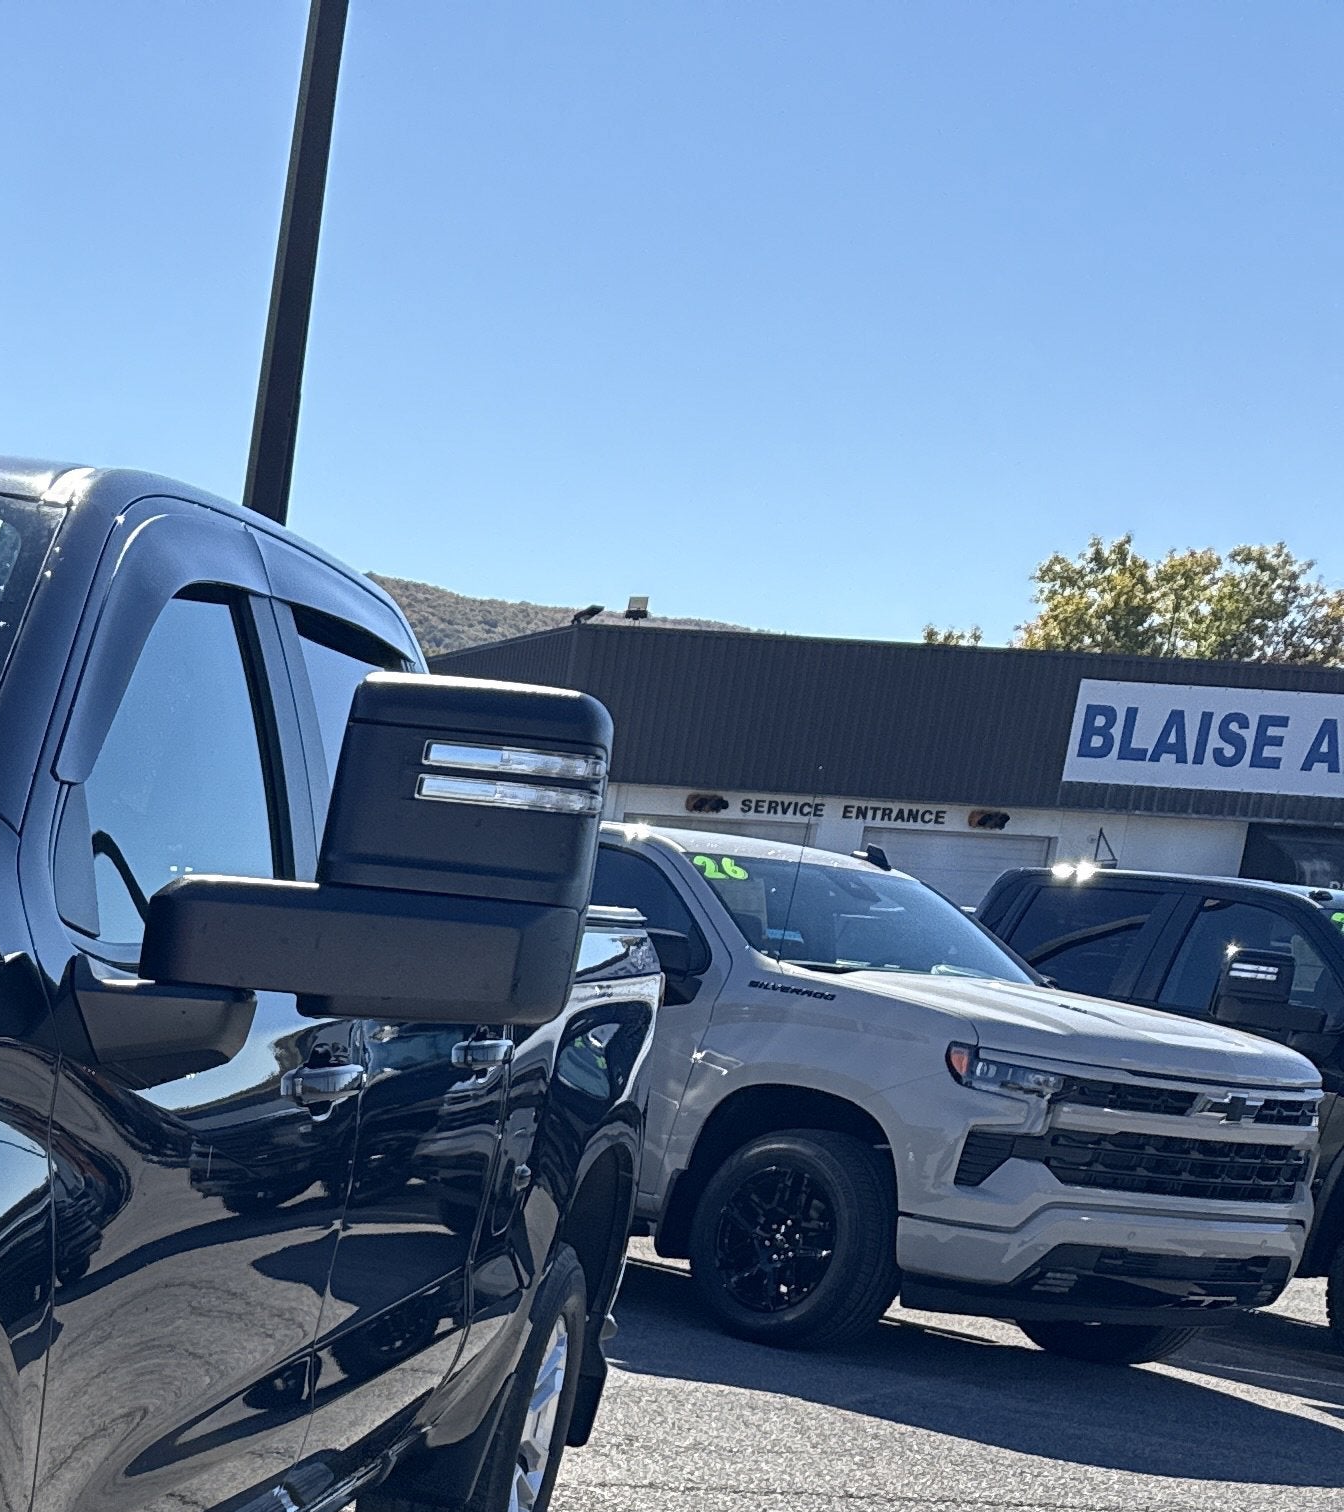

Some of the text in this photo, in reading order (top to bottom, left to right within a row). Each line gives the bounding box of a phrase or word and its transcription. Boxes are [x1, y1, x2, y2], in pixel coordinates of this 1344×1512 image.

[1077, 703, 1341, 774] BLAISE A
[740, 799, 947, 825] SERVICE ENTRANCE
[693, 855, 749, 880] 26
[747, 980, 837, 1001] SILVERADO
